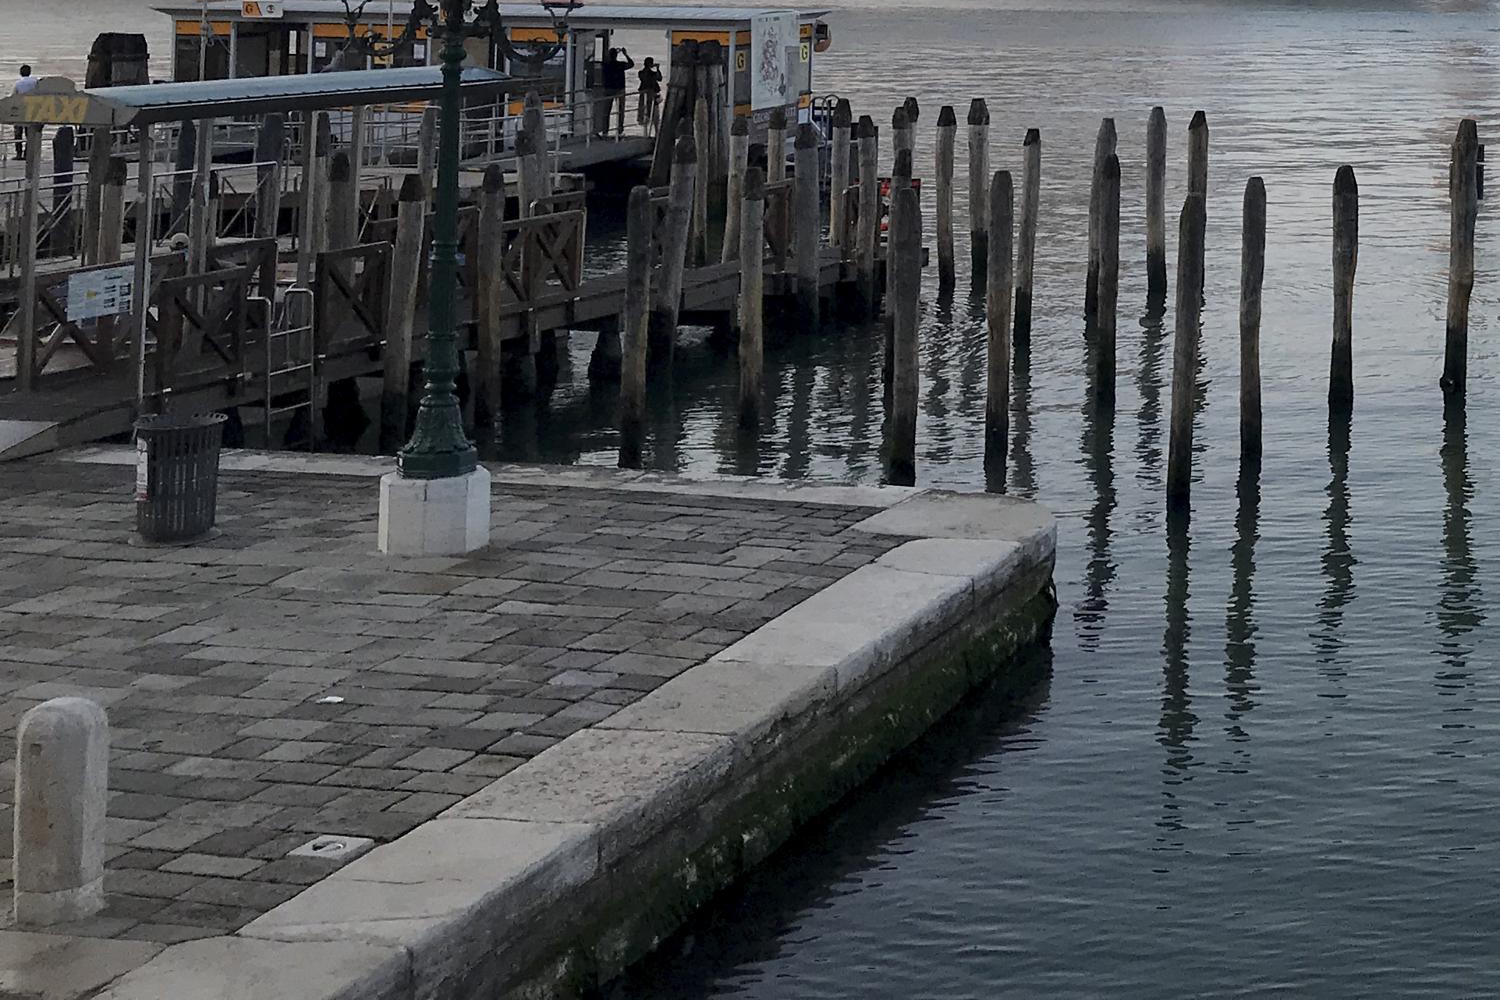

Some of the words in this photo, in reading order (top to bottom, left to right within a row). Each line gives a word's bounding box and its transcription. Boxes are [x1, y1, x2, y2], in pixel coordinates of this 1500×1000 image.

[737, 52, 745, 69] G
[801, 44, 808, 60] G
[23, 95, 89, 123] TAXI
